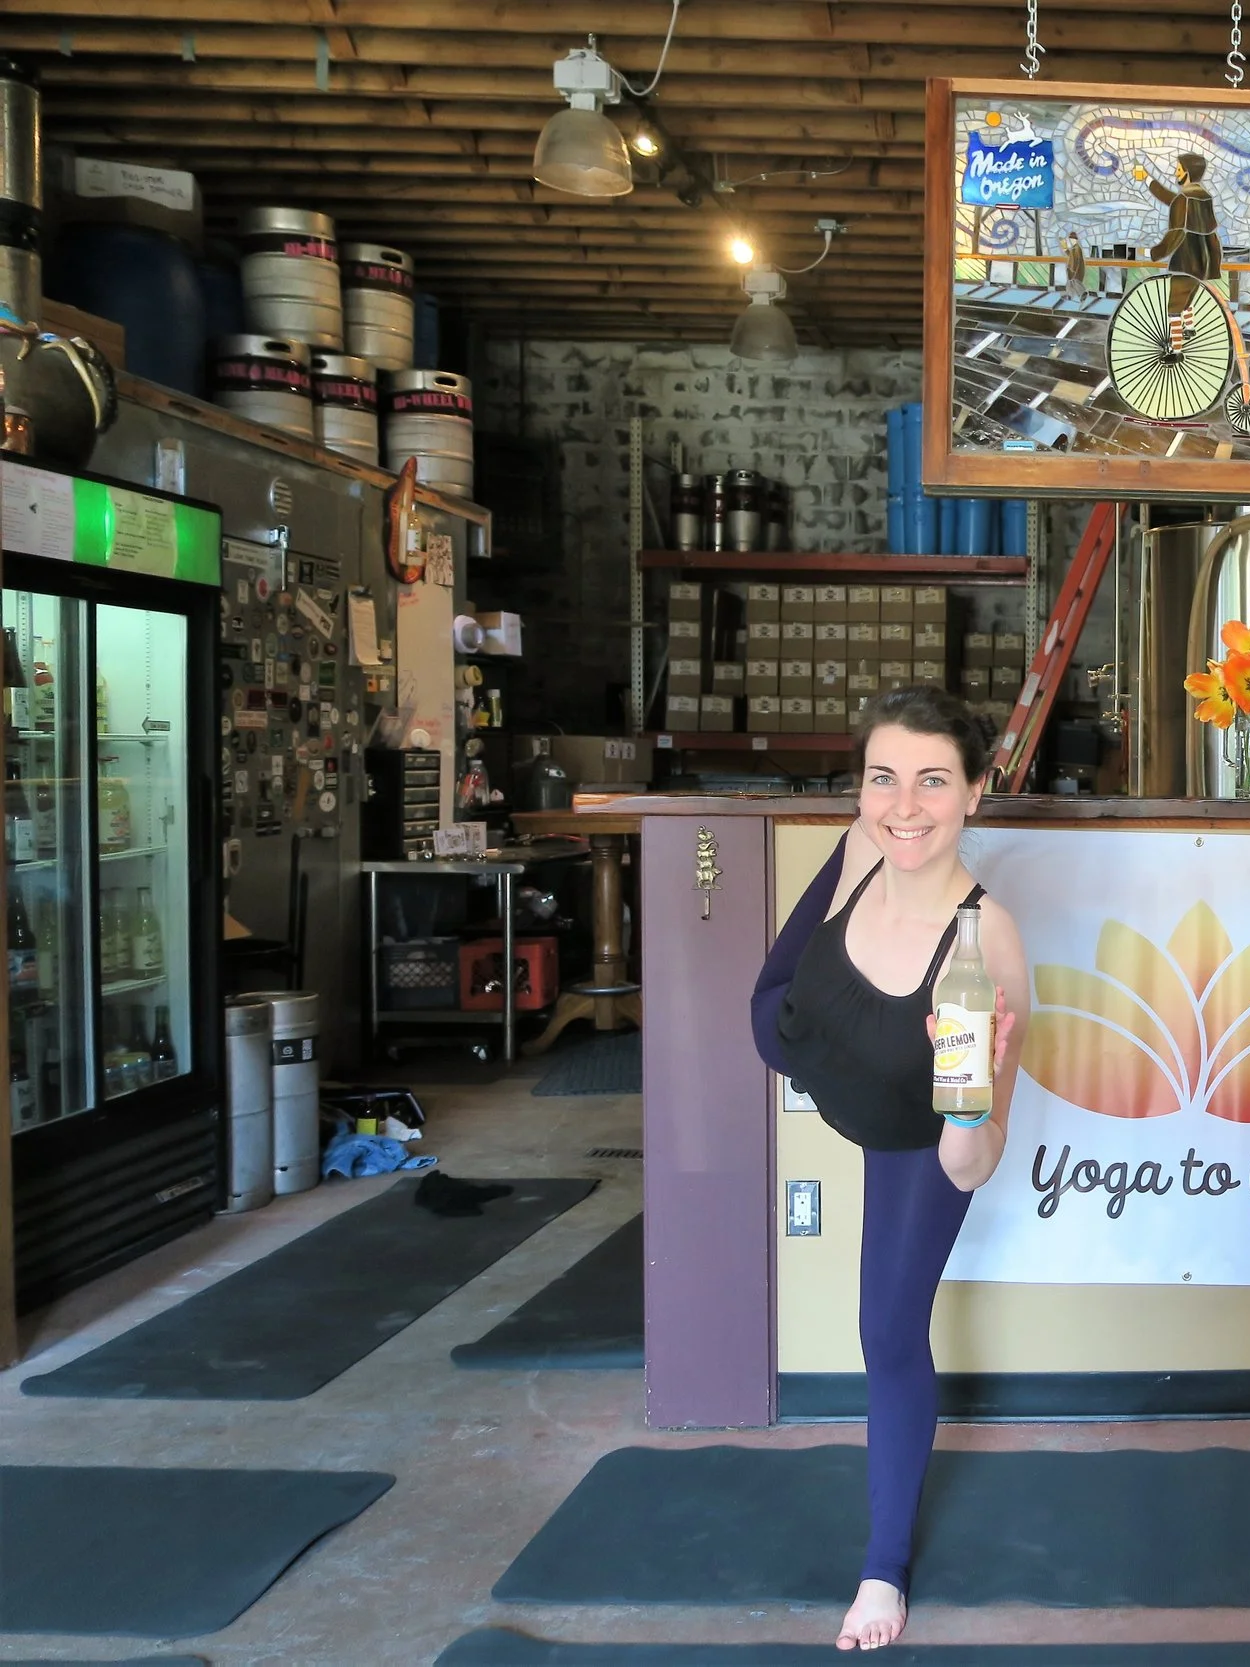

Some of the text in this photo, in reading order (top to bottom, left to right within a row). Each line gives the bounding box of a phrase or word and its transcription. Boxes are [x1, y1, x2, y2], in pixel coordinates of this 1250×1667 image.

[970, 150, 1048, 178] Made in
[980, 174, 1045, 202] Oregon
[947, 1032, 976, 1048] LEMON
[1032, 1144, 1174, 1219] Yoga
[1180, 1148, 1241, 1196] to
